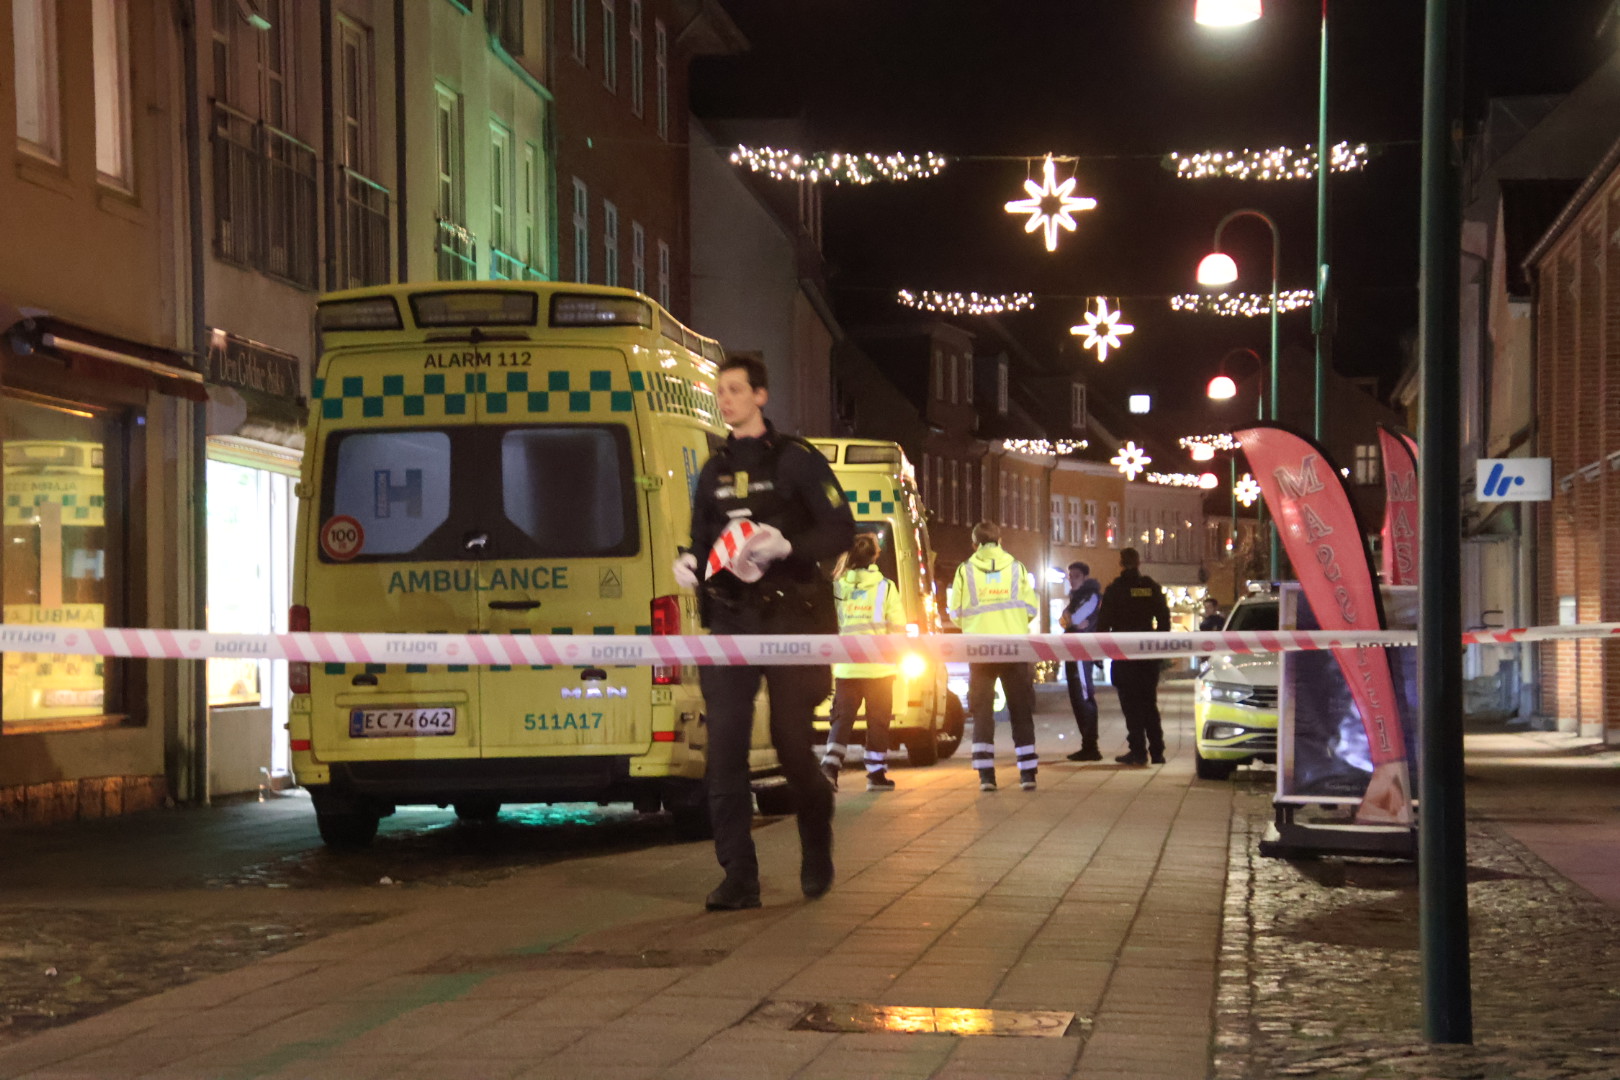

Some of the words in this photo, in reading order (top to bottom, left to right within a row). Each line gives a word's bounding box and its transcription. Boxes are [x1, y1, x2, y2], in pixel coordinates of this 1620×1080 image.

[424, 353, 491, 368] ALARM
[497, 351, 532, 367] 112
[331, 529, 356, 542] 100
[1390, 471, 1415, 585] MAS
[388, 567, 568, 593] AMBULANCE
[561, 687, 627, 699] MAN
[524, 712, 603, 731] 511A17
